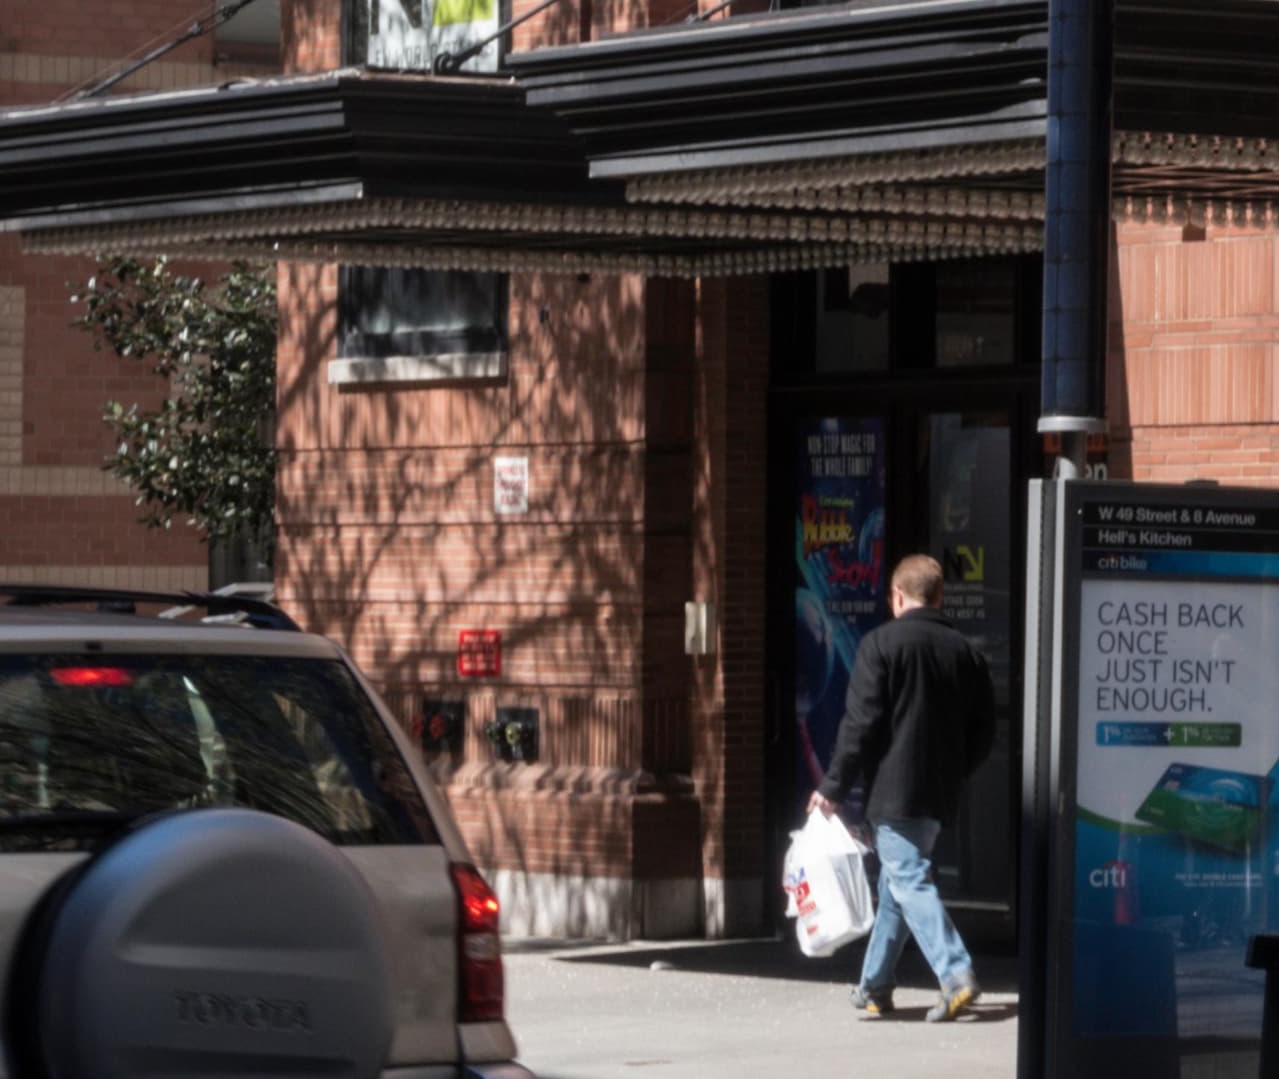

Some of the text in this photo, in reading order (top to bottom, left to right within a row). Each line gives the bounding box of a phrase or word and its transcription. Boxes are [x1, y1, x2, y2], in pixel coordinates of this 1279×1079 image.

[1098, 506, 1113, 520] W
[1115, 507, 1133, 522] 49
[1135, 507, 1178, 523] Street
[1180, 509, 1191, 524] &
[1204, 510, 1257, 526] Avenue
[1098, 529, 1192, 547] Hell's Kitchen
[1098, 601, 1245, 628] CASH BACK
[1097, 630, 1168, 655] ONCE
[1096, 659, 1236, 685] JUST ISN'T
[1096, 687, 1213, 712] ENOUGH.
[1089, 863, 1126, 888] citi
[175, 991, 312, 1030] TOYOTA
